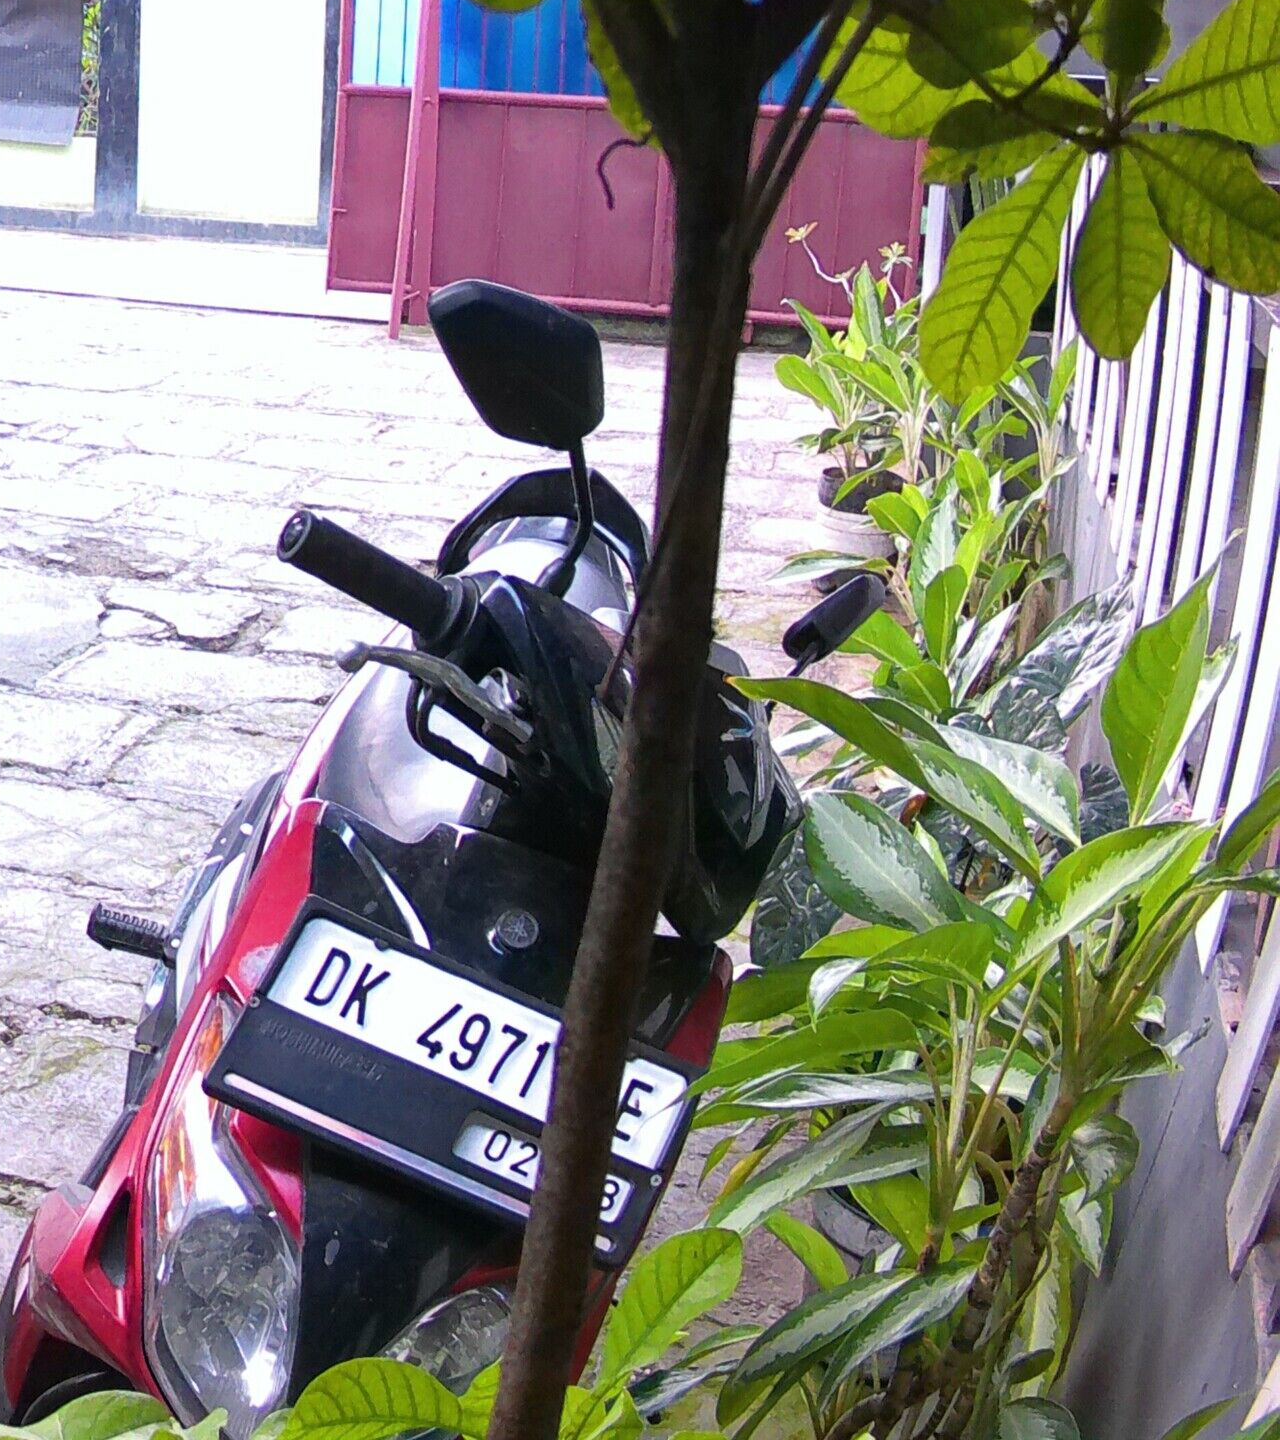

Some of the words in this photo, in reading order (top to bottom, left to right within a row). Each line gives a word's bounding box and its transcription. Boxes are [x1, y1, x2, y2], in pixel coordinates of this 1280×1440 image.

[304, 946, 392, 1027] DK
[415, 1003, 552, 1099] 4971
[484, 1129, 539, 1178] 02
